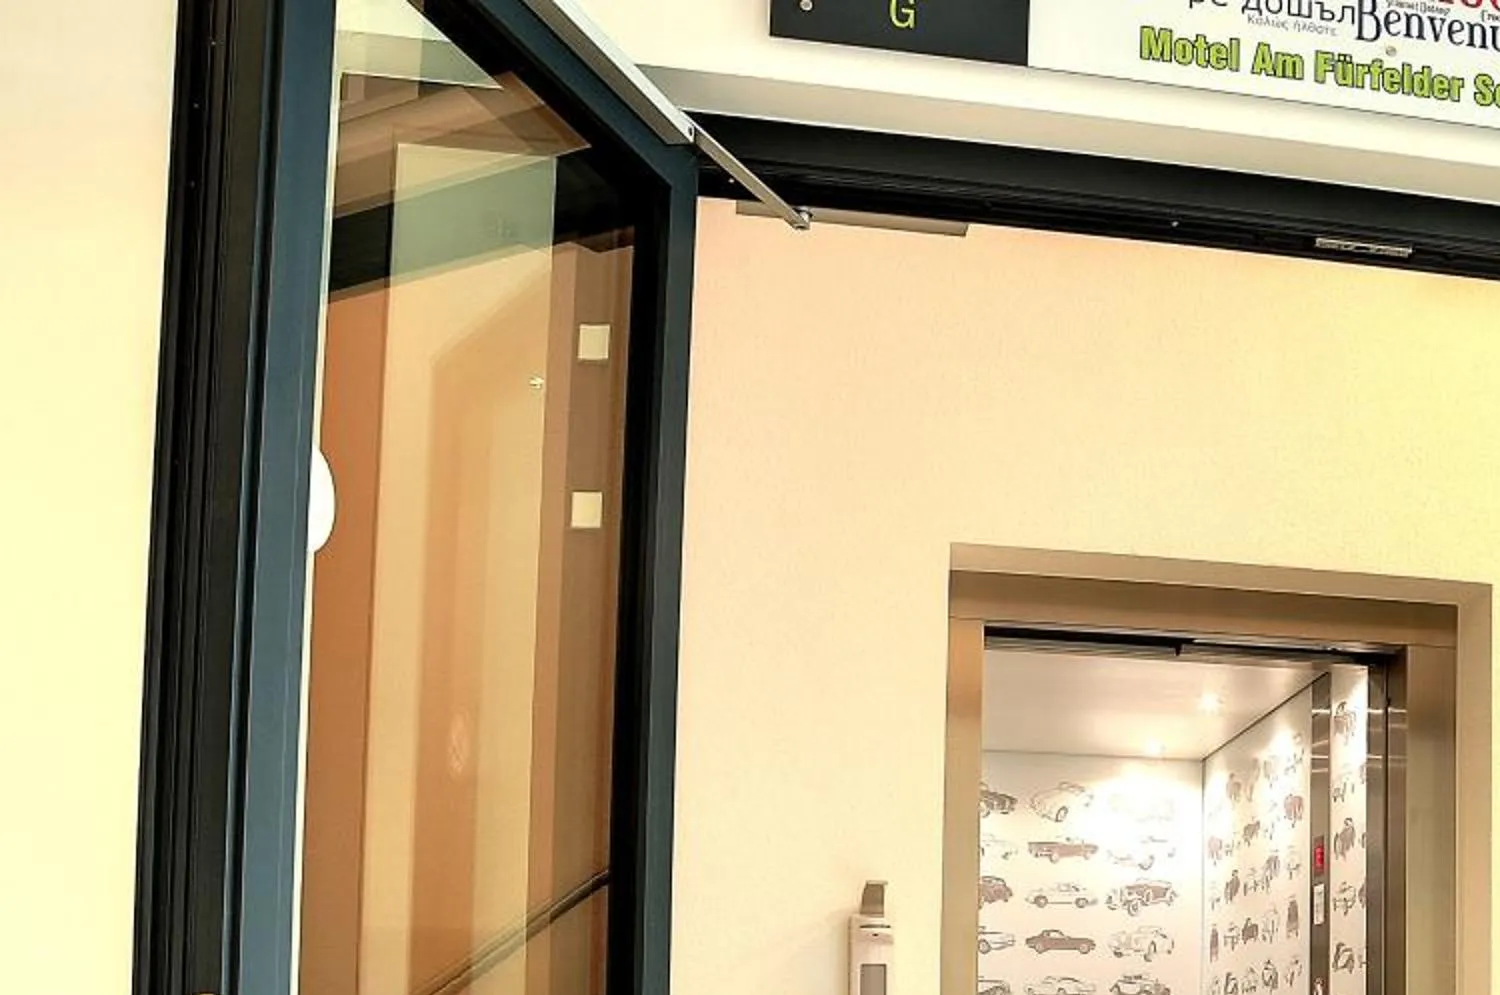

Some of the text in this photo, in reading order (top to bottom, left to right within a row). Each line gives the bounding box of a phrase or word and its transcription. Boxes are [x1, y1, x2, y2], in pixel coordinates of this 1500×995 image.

[1140, 26, 1240, 71] Motel
[1251, 42, 1304, 80] Am
[1314, 50, 1464, 102] Fürfelder
